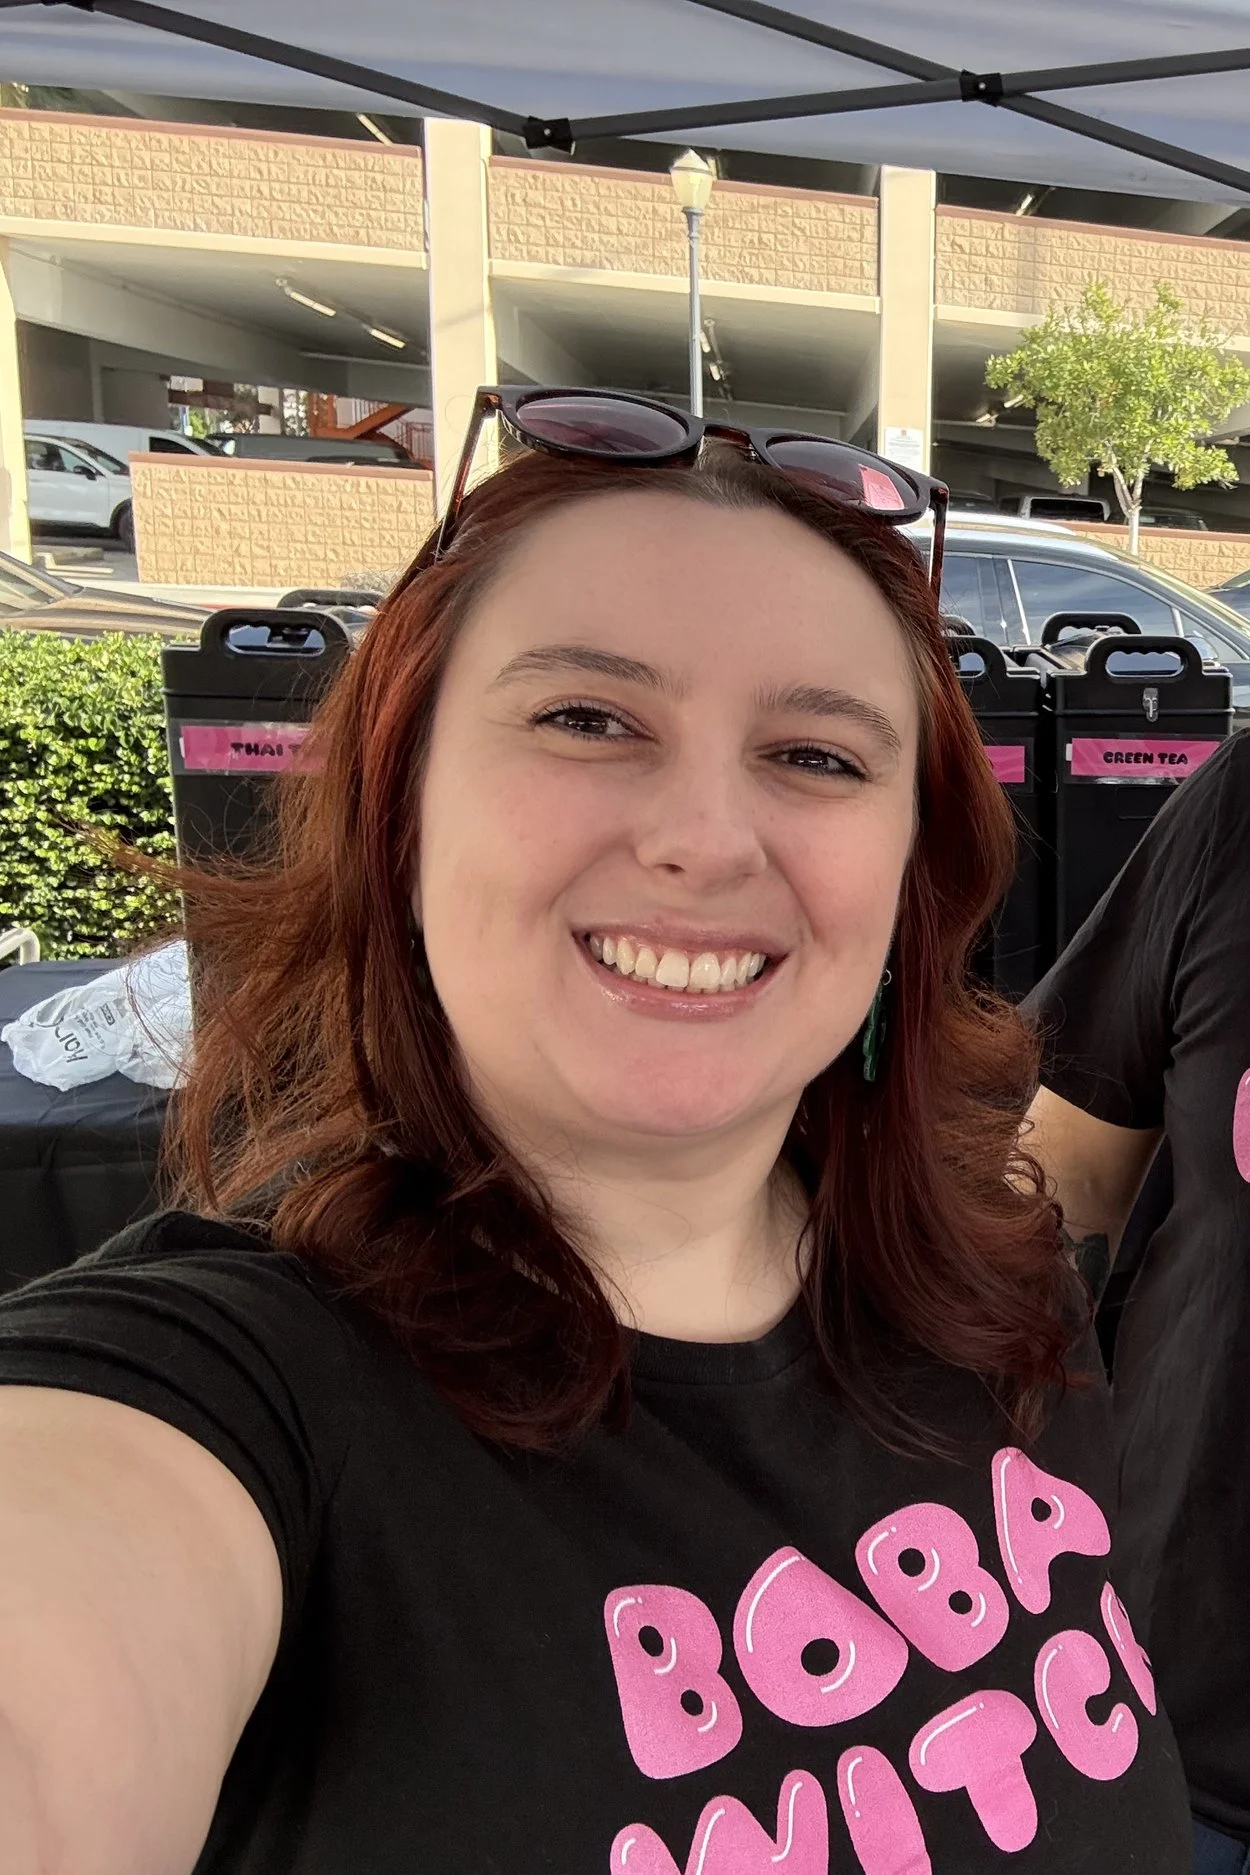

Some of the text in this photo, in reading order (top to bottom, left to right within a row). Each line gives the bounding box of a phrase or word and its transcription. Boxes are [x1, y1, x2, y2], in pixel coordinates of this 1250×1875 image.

[230, 742, 284, 757] THAI
[1103, 751, 1188, 765] GREEN TEA
[604, 1447, 1110, 1779] BOBA
